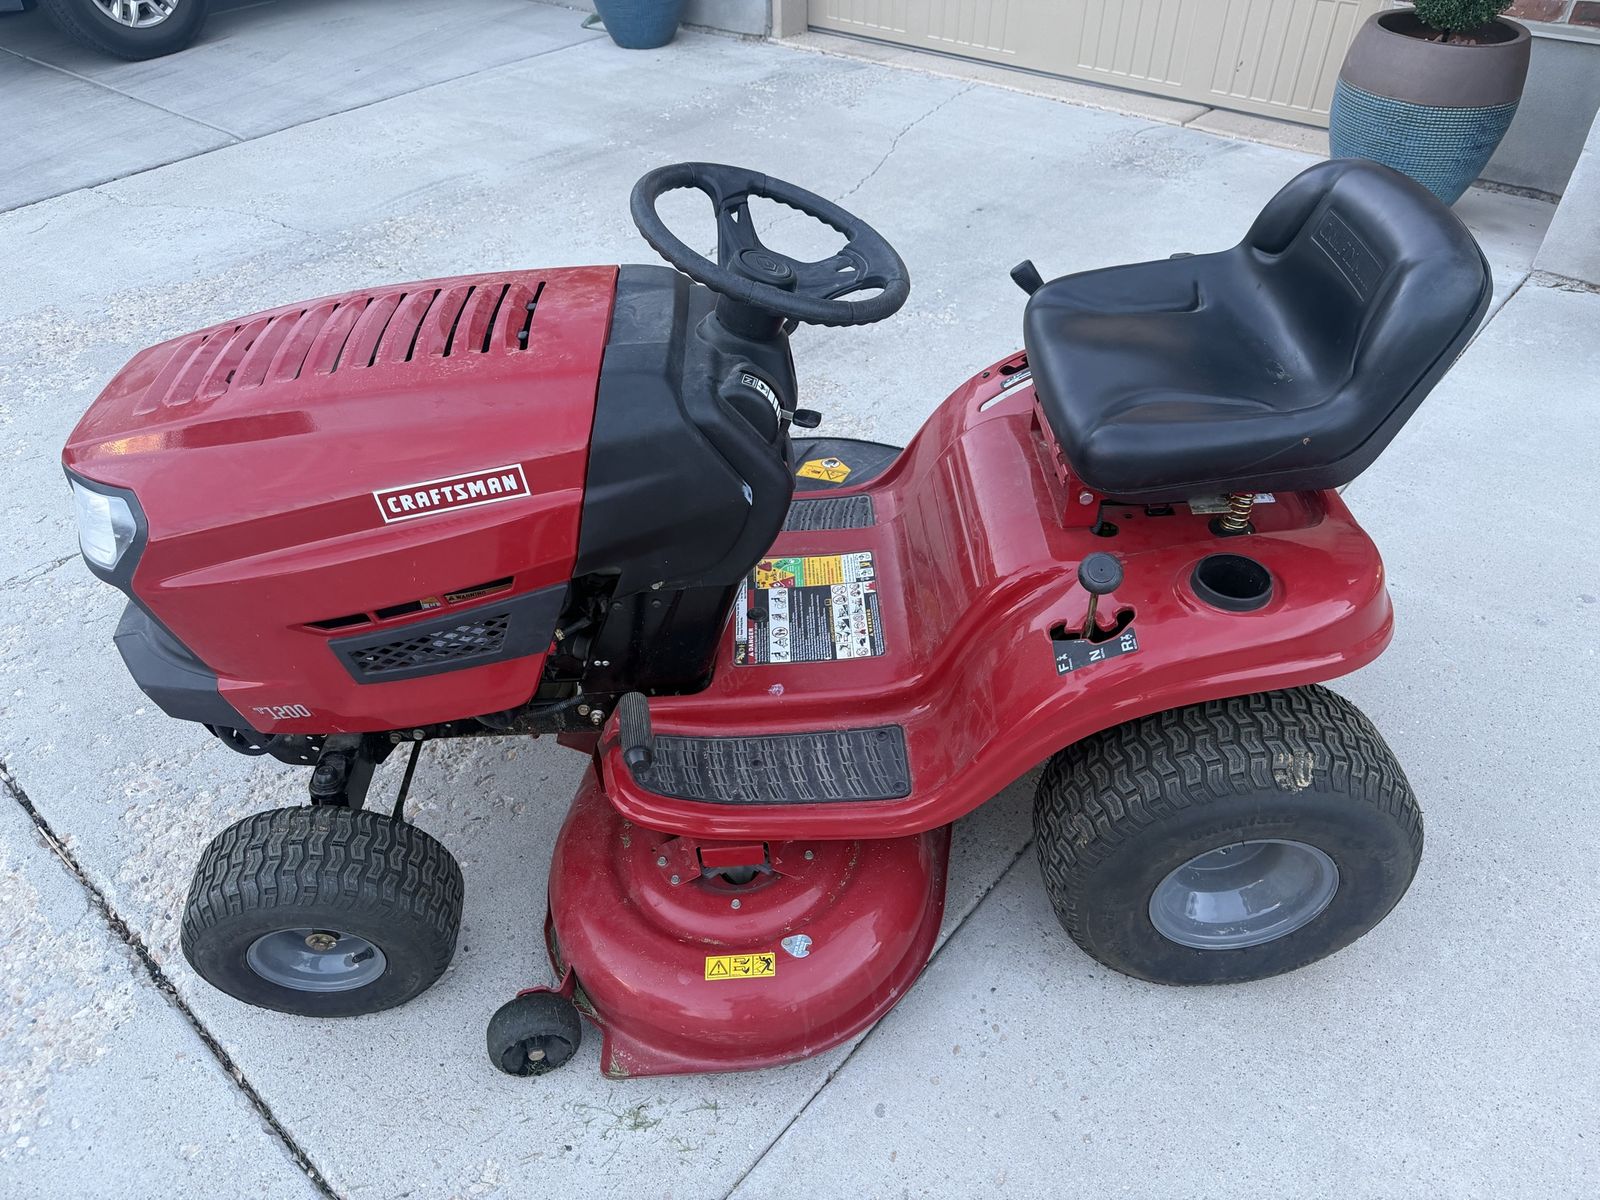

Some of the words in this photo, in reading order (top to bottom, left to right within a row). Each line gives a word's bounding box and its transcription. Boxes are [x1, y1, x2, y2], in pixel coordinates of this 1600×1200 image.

[386, 474, 518, 513] CRAFTSMAN
[1121, 641, 1133, 652] R
[1088, 649, 1101, 662] N
[1058, 664, 1069, 673] F
